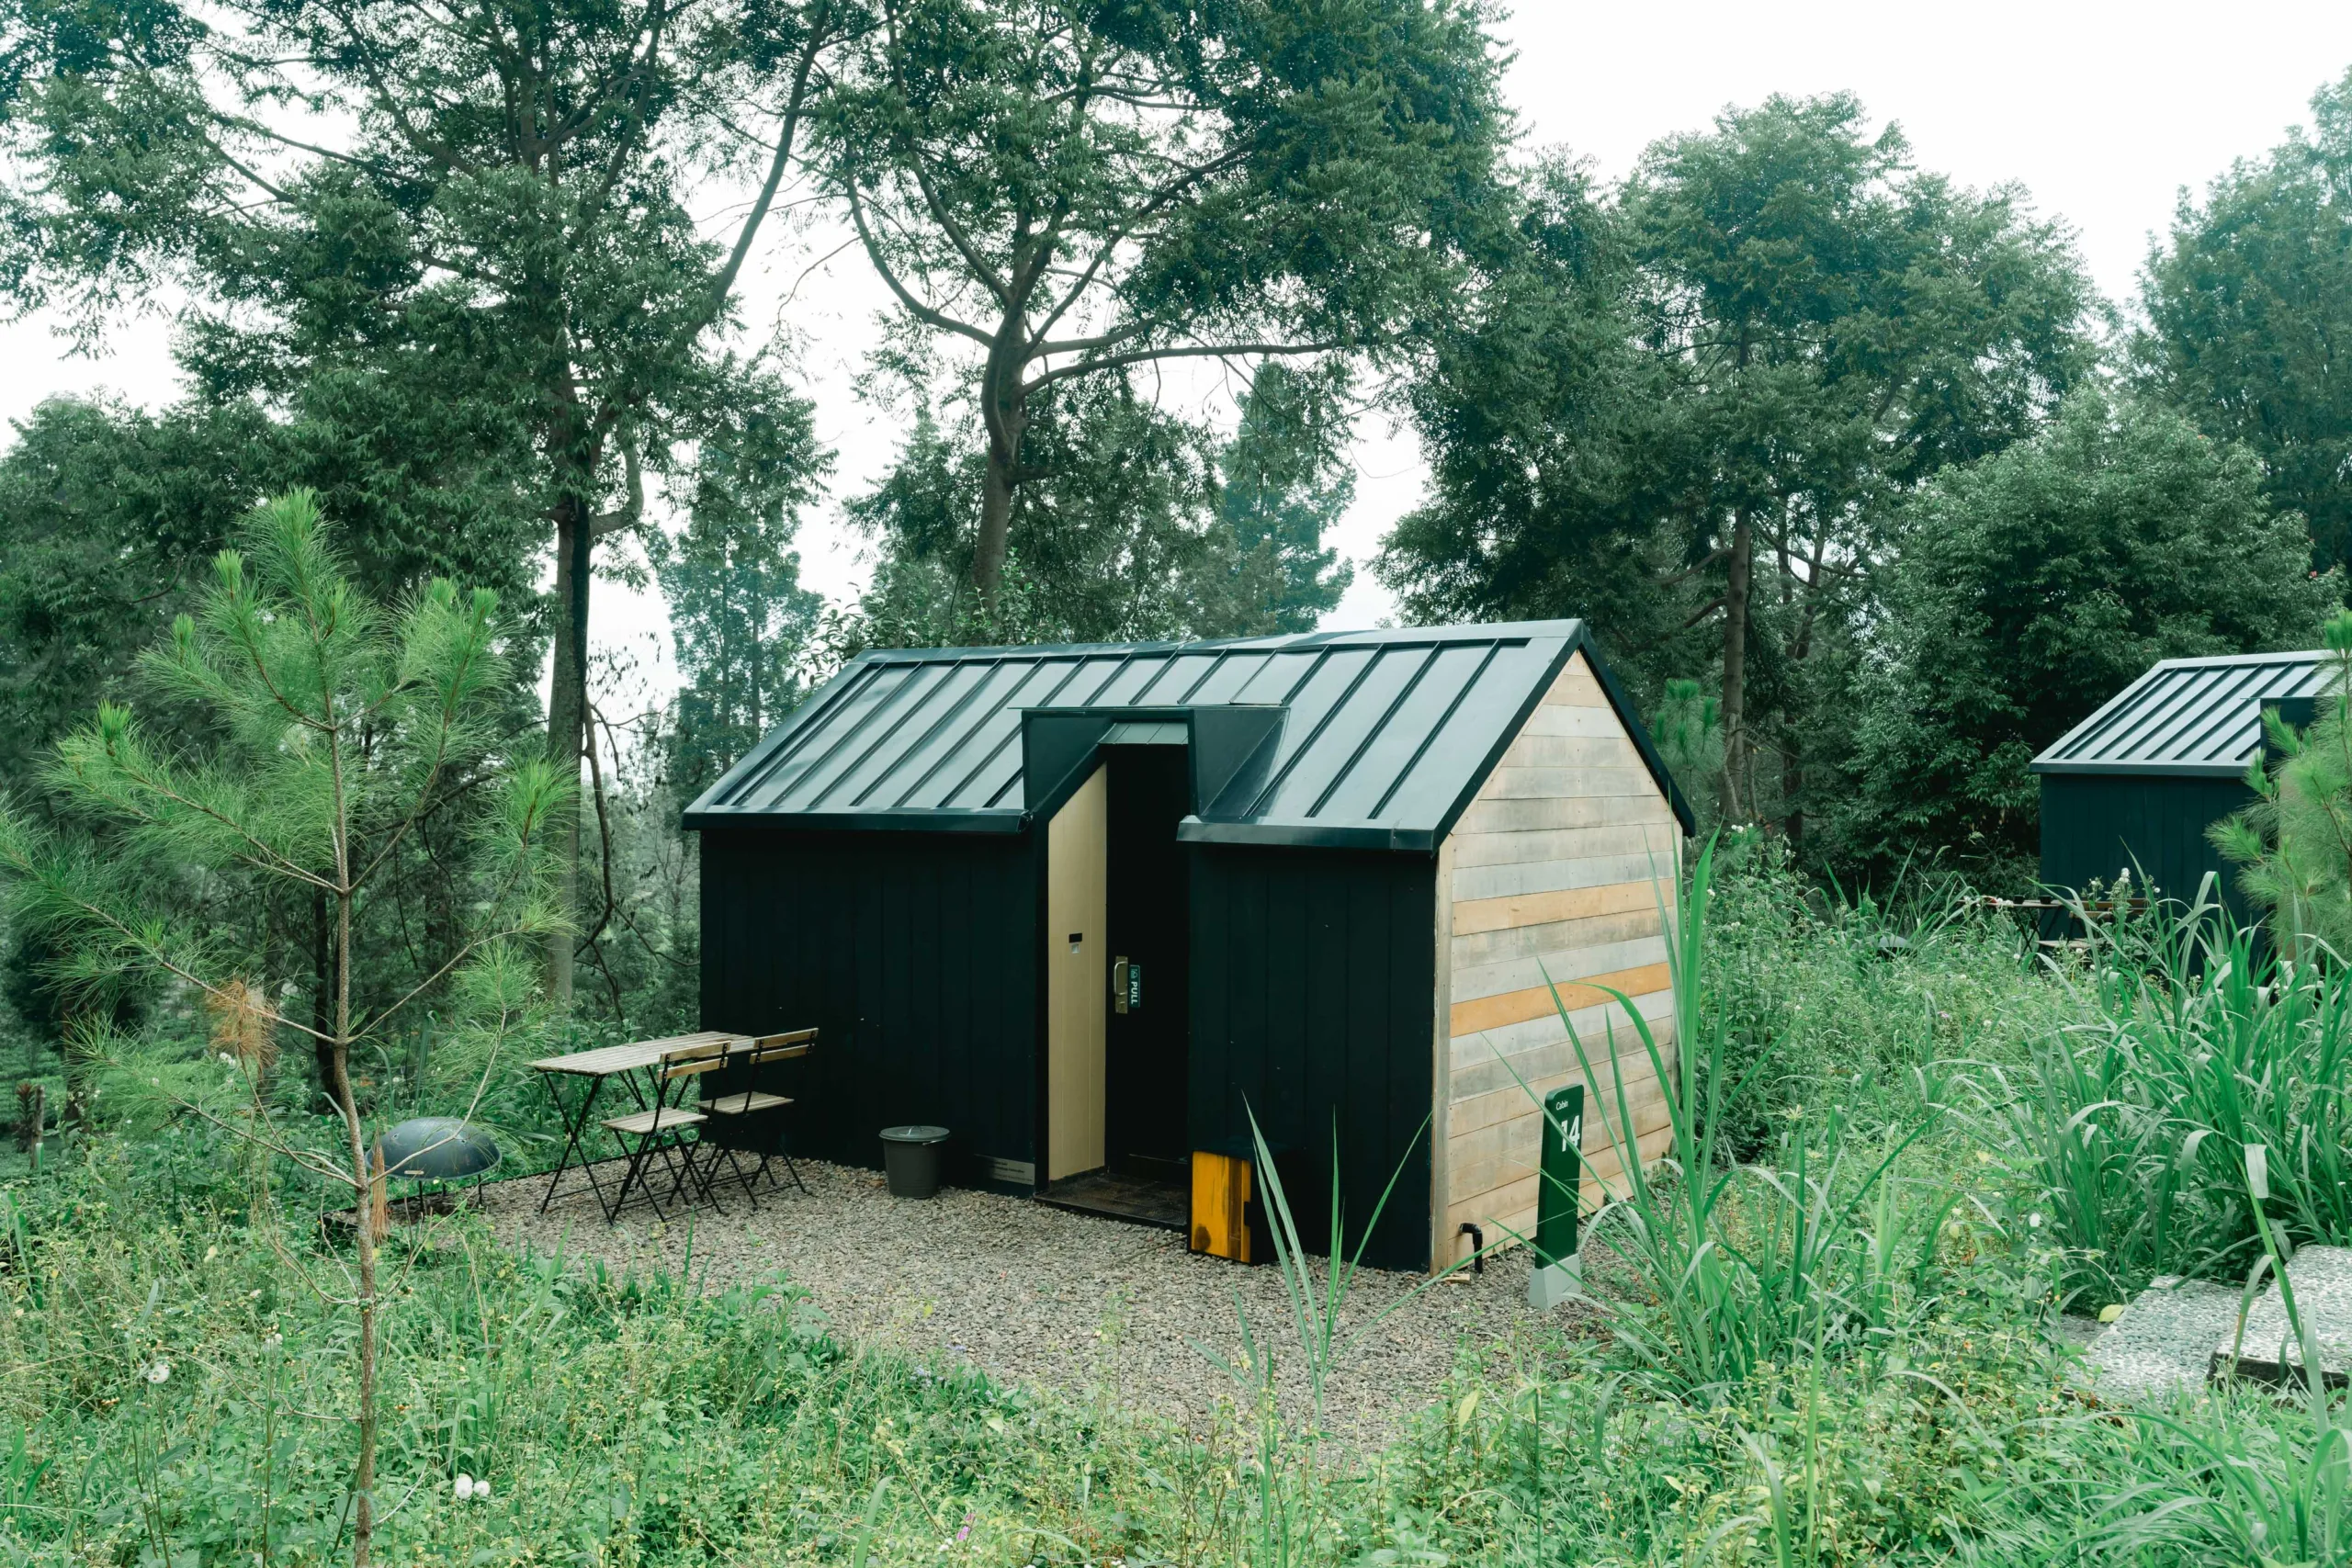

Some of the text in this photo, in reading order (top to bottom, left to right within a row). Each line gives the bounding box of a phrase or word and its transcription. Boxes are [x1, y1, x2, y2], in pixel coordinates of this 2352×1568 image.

[1130, 981, 1138, 1005] PULL
[1555, 1100, 1569, 1111] Cabin
[1561, 1114, 1580, 1152] 14
